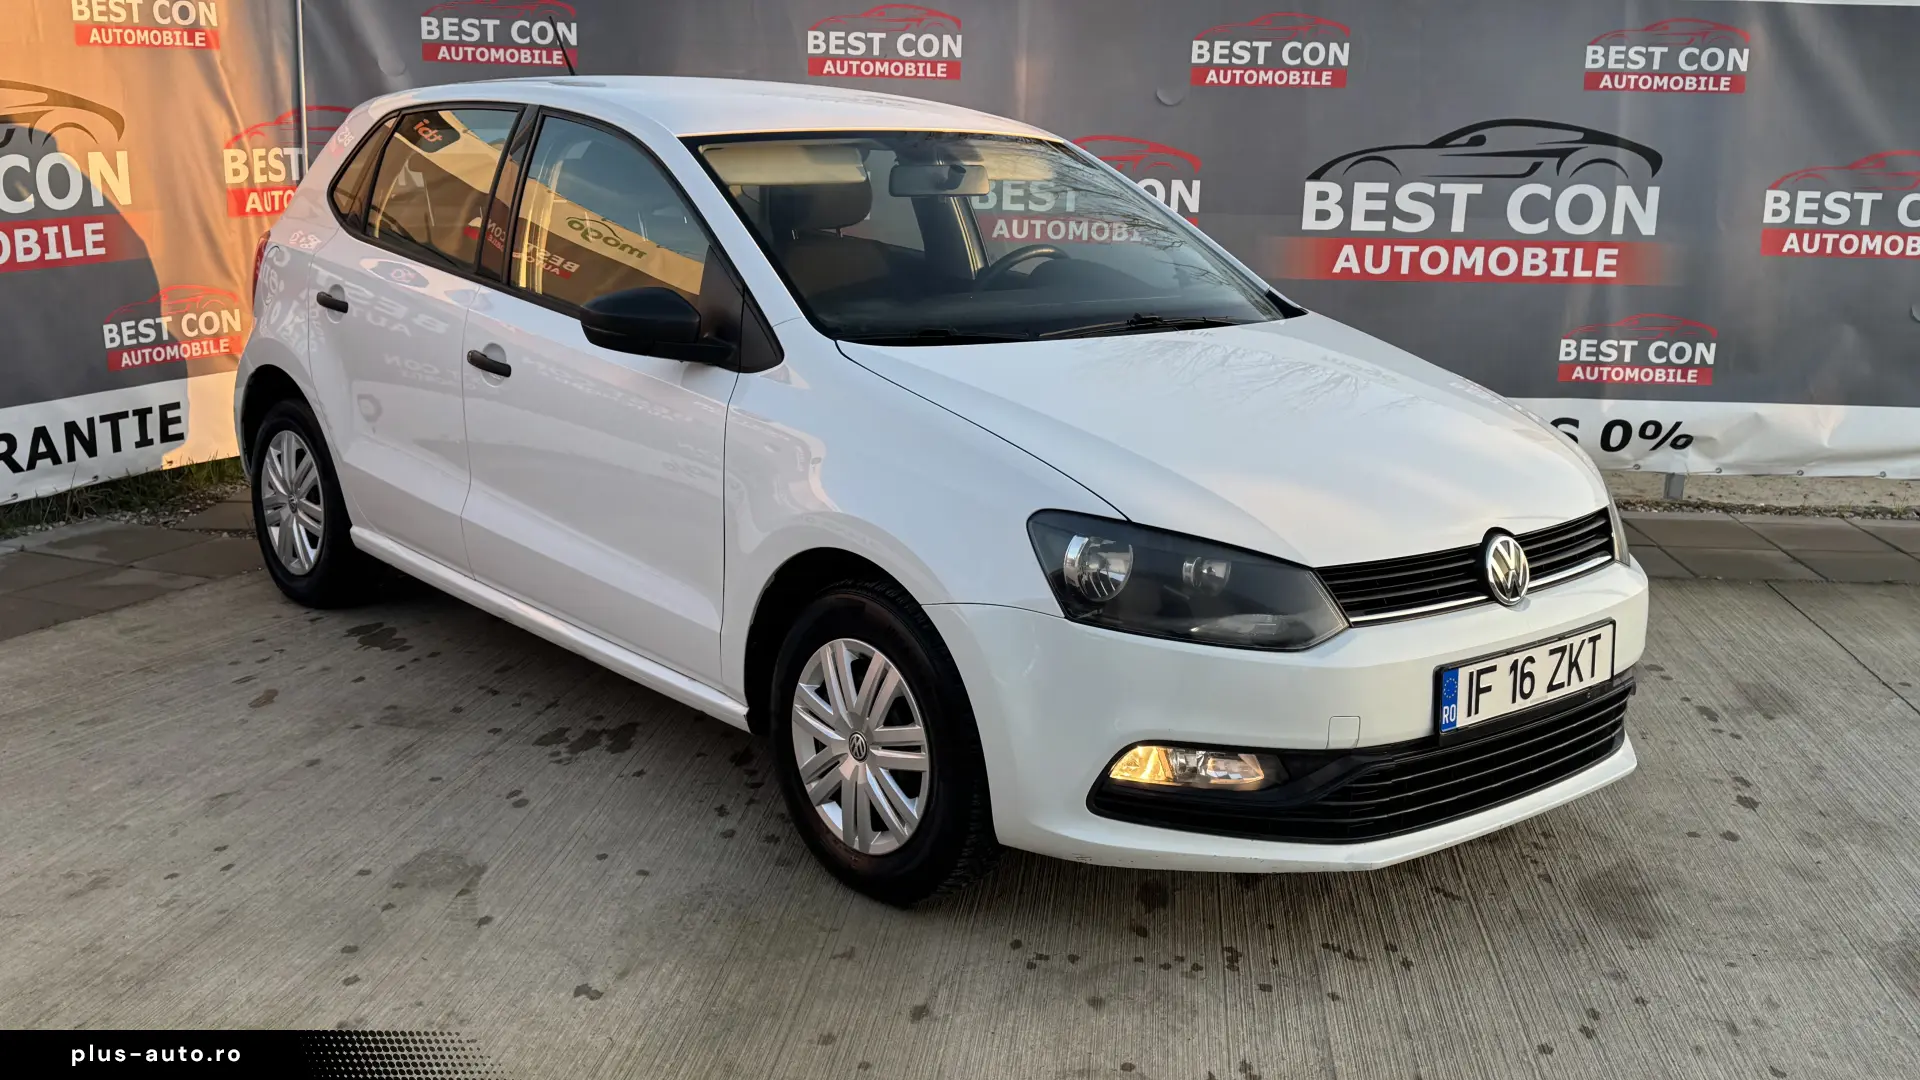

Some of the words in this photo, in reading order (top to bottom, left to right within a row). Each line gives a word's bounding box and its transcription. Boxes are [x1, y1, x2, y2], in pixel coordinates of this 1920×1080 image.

[72, 0, 143, 23] BEST
[153, 1, 218, 26] CON
[89, 28, 206, 47] AUTOMOBILE
[420, 16, 499, 41] BEST
[510, 21, 578, 46] CON
[807, 31, 886, 55] BEST
[896, 34, 962, 58] CON
[437, 46, 564, 65] AUTOMOBILE
[1191, 40, 1272, 65] BEST
[1281, 42, 1350, 66] CON
[1585, 45, 1668, 70] BEST
[1678, 47, 1750, 72] CON
[822, 60, 947, 79] AUTOMOBILE
[1205, 69, 1332, 86] AUTOMOBILE
[1599, 75, 1731, 92] AUTOMOBILE
[223, 147, 303, 184] BEST
[0, 151, 132, 214] CON
[1301, 181, 1483, 233] BEST
[1506, 184, 1660, 236] CON
[1762, 189, 1883, 227] BEST
[1782, 232, 1920, 256] AUTOMOB
[1332, 245, 1619, 278] AUTOMOBILE
[103, 316, 172, 349] BEST
[181, 308, 242, 337] CON
[121, 338, 230, 368] AUTOMOBILE
[1558, 339, 1638, 363] BEST
[1648, 341, 1717, 365] CON
[1571, 367, 1698, 384] AUTOMOBILE
[1600, 418, 1695, 452] 0%
[1467, 665, 1498, 718] IF
[1508, 655, 1536, 704] 16
[1547, 633, 1602, 694] ZKT
[1442, 704, 1456, 725] RO
